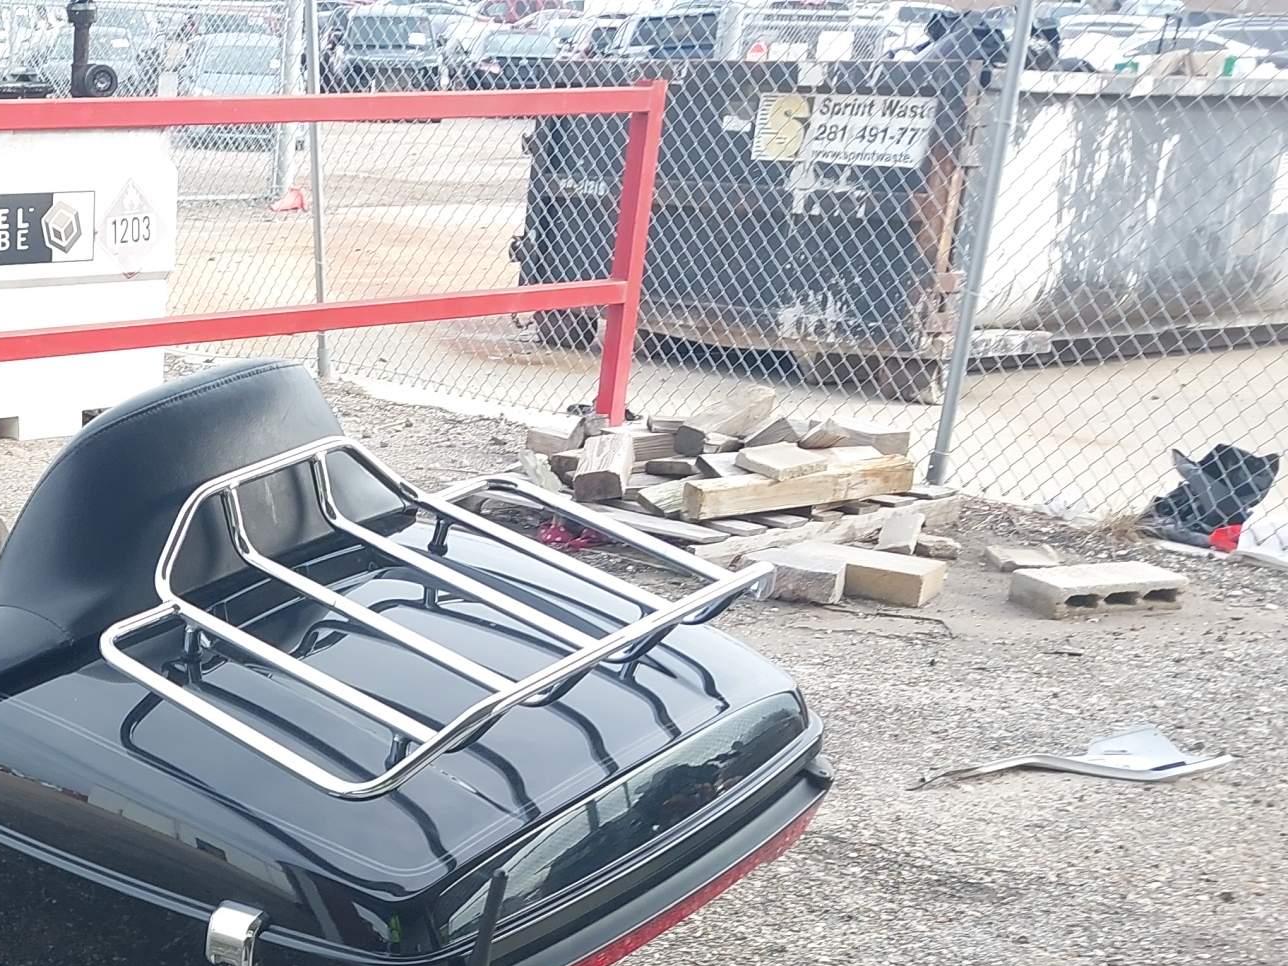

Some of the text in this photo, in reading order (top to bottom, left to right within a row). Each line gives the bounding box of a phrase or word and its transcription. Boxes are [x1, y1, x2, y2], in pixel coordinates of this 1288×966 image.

[819, 97, 875, 117] Sprint
[814, 124, 848, 142] 281
[111, 215, 151, 245] 1203
